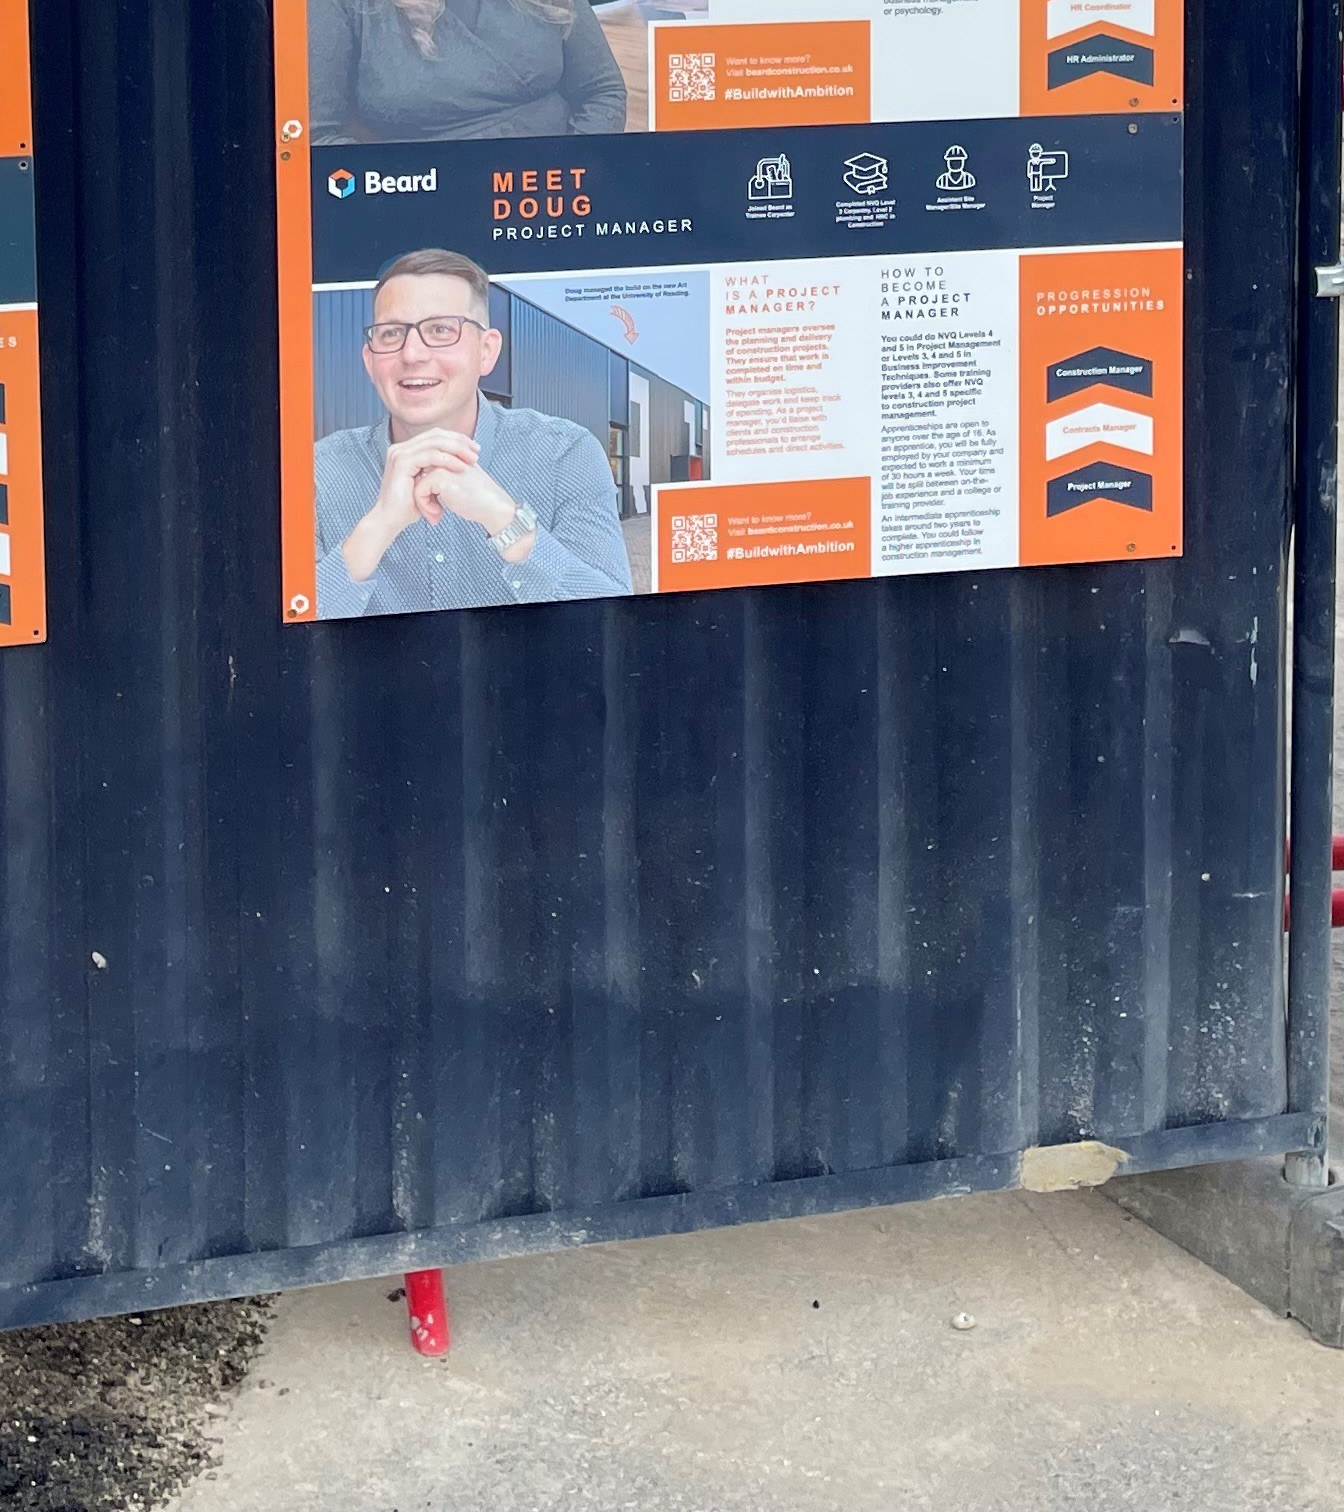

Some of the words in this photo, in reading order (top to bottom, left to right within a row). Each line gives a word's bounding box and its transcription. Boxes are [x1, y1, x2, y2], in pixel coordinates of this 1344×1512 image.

[1067, 55, 1079, 63] HR
[1081, 54, 1135, 63] Administrator
[725, 85, 853, 100] #BuildwithAmbition
[365, 168, 436, 194] Beard
[493, 169, 586, 192] MEET
[494, 195, 590, 220] DOUG
[493, 224, 584, 240] PROJECT
[596, 219, 692, 235] MANAGER
[725, 275, 768, 287] WHAT
[726, 291, 740, 300] IS
[749, 290, 757, 299] A
[766, 285, 840, 298] PROJECT
[726, 301, 815, 314] MANAGER?
[1067, 482, 1096, 492] Project
[1097, 481, 1131, 490] Manager
[727, 541, 854, 559] #BuildwithAmbition
